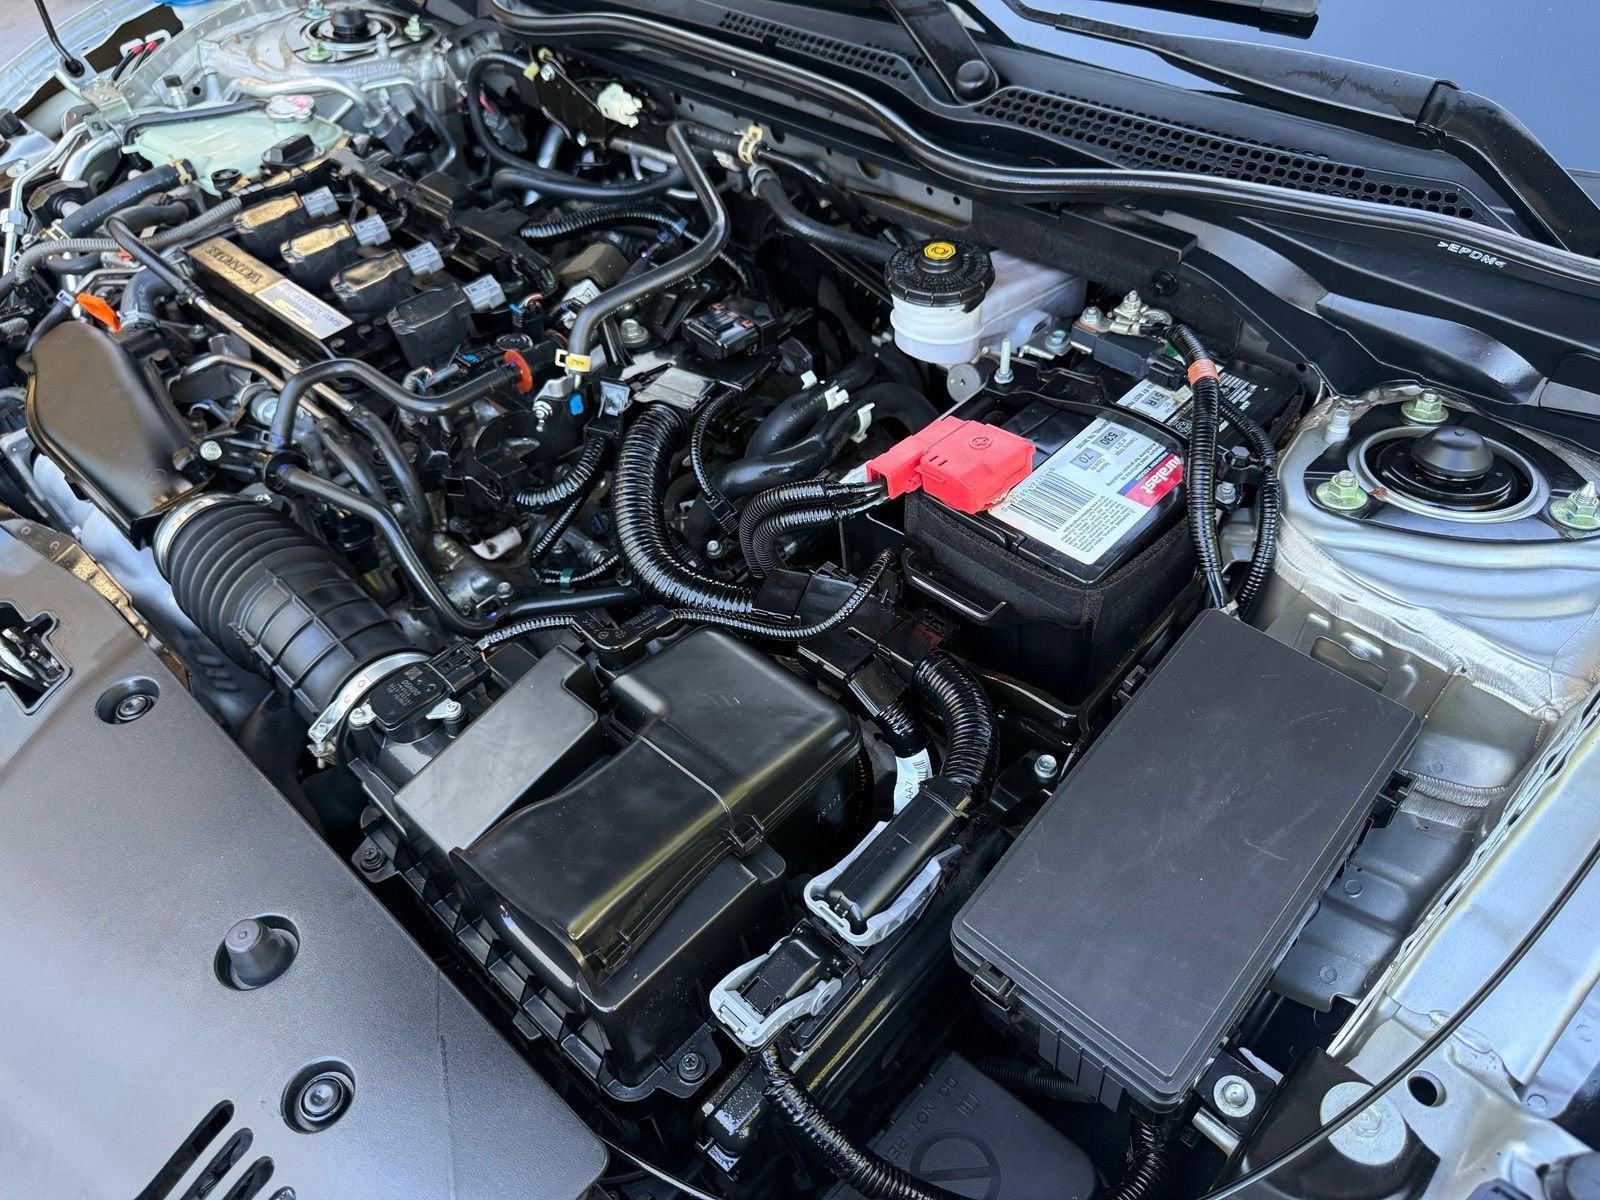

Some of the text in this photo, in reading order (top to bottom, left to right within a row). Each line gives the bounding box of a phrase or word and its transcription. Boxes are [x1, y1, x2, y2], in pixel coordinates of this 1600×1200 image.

[206, 247, 261, 284] HONDA
[1146, 392, 1164, 406] 51R
[1098, 431, 1118, 445] 530
[1077, 452, 1094, 463] 70
[939, 1076, 958, 1097] DO
[910, 1101, 937, 1132] NOT
